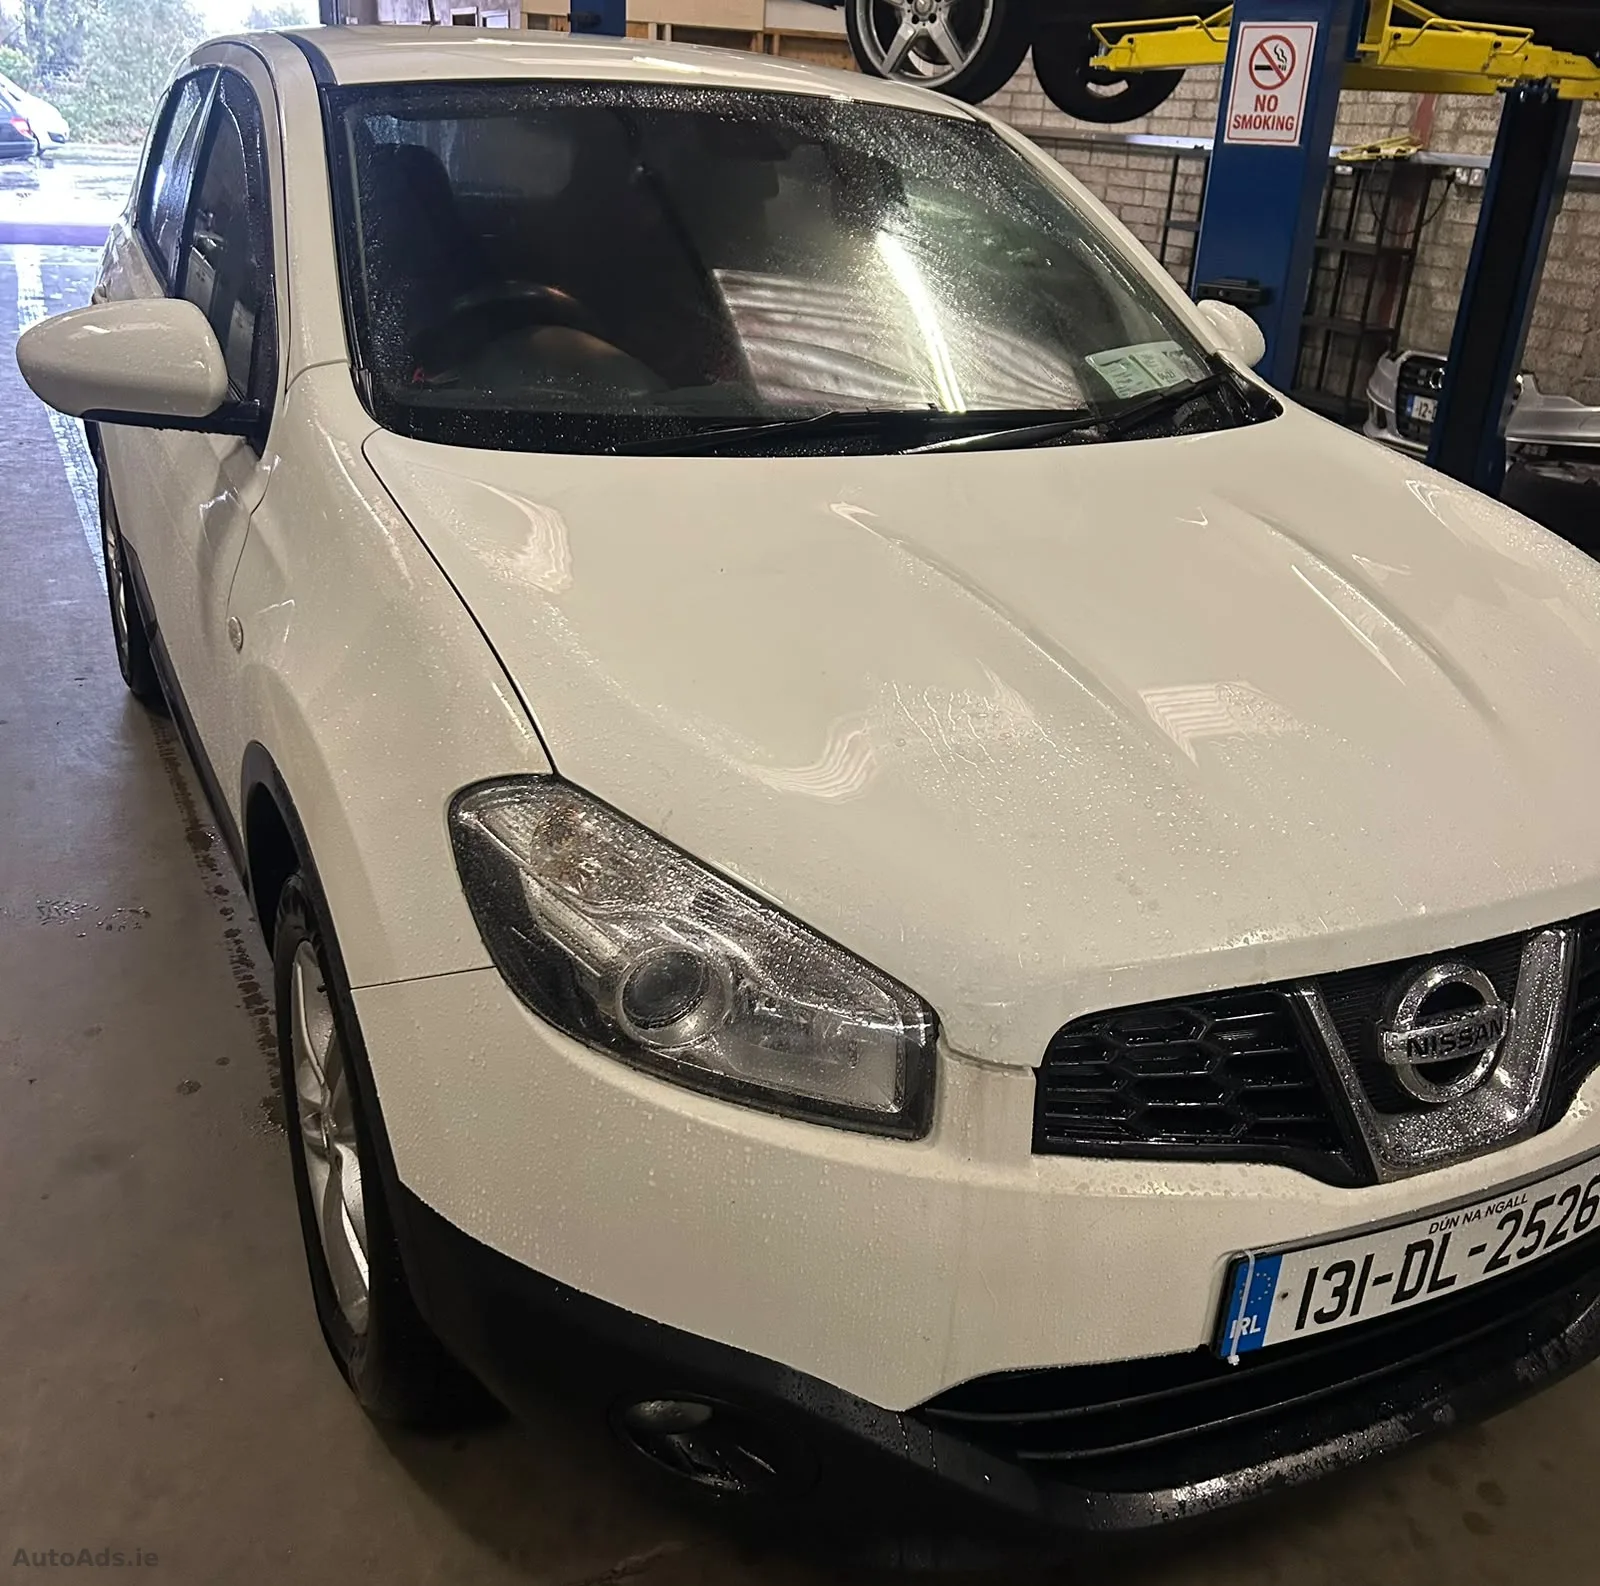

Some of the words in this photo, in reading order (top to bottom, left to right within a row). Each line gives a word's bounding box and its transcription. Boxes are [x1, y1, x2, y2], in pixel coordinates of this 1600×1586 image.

[1254, 94, 1279, 112] NO
[1232, 114, 1295, 131] SMOKING
[1406, 1019, 1503, 1058] NISSAN
[1428, 1215, 1460, 1235] DÚN
[1462, 1209, 1481, 1225] NA
[1484, 1193, 1528, 1217] NGALL
[1229, 1314, 1261, 1339] IRL
